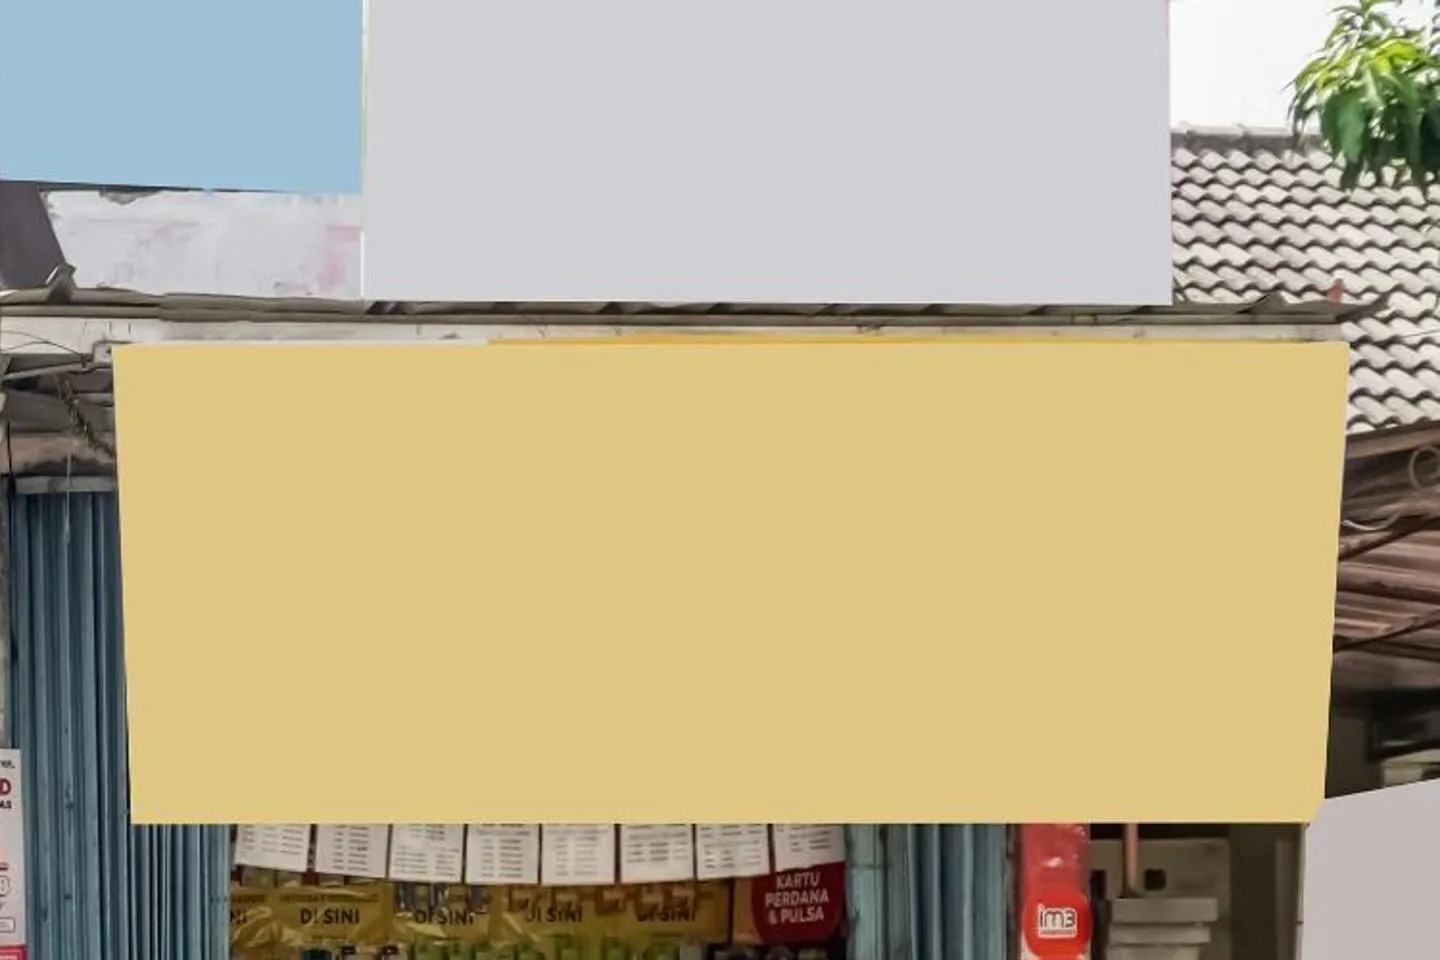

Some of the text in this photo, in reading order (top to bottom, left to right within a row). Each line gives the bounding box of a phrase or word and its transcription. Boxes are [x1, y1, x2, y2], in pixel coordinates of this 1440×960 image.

[777, 872, 821, 889] KARTU
[764, 888, 829, 907] PERDANA
[323, 908, 360, 925] SINI
[780, 906, 825, 923] PULSA
[1039, 905, 1076, 928] im3
